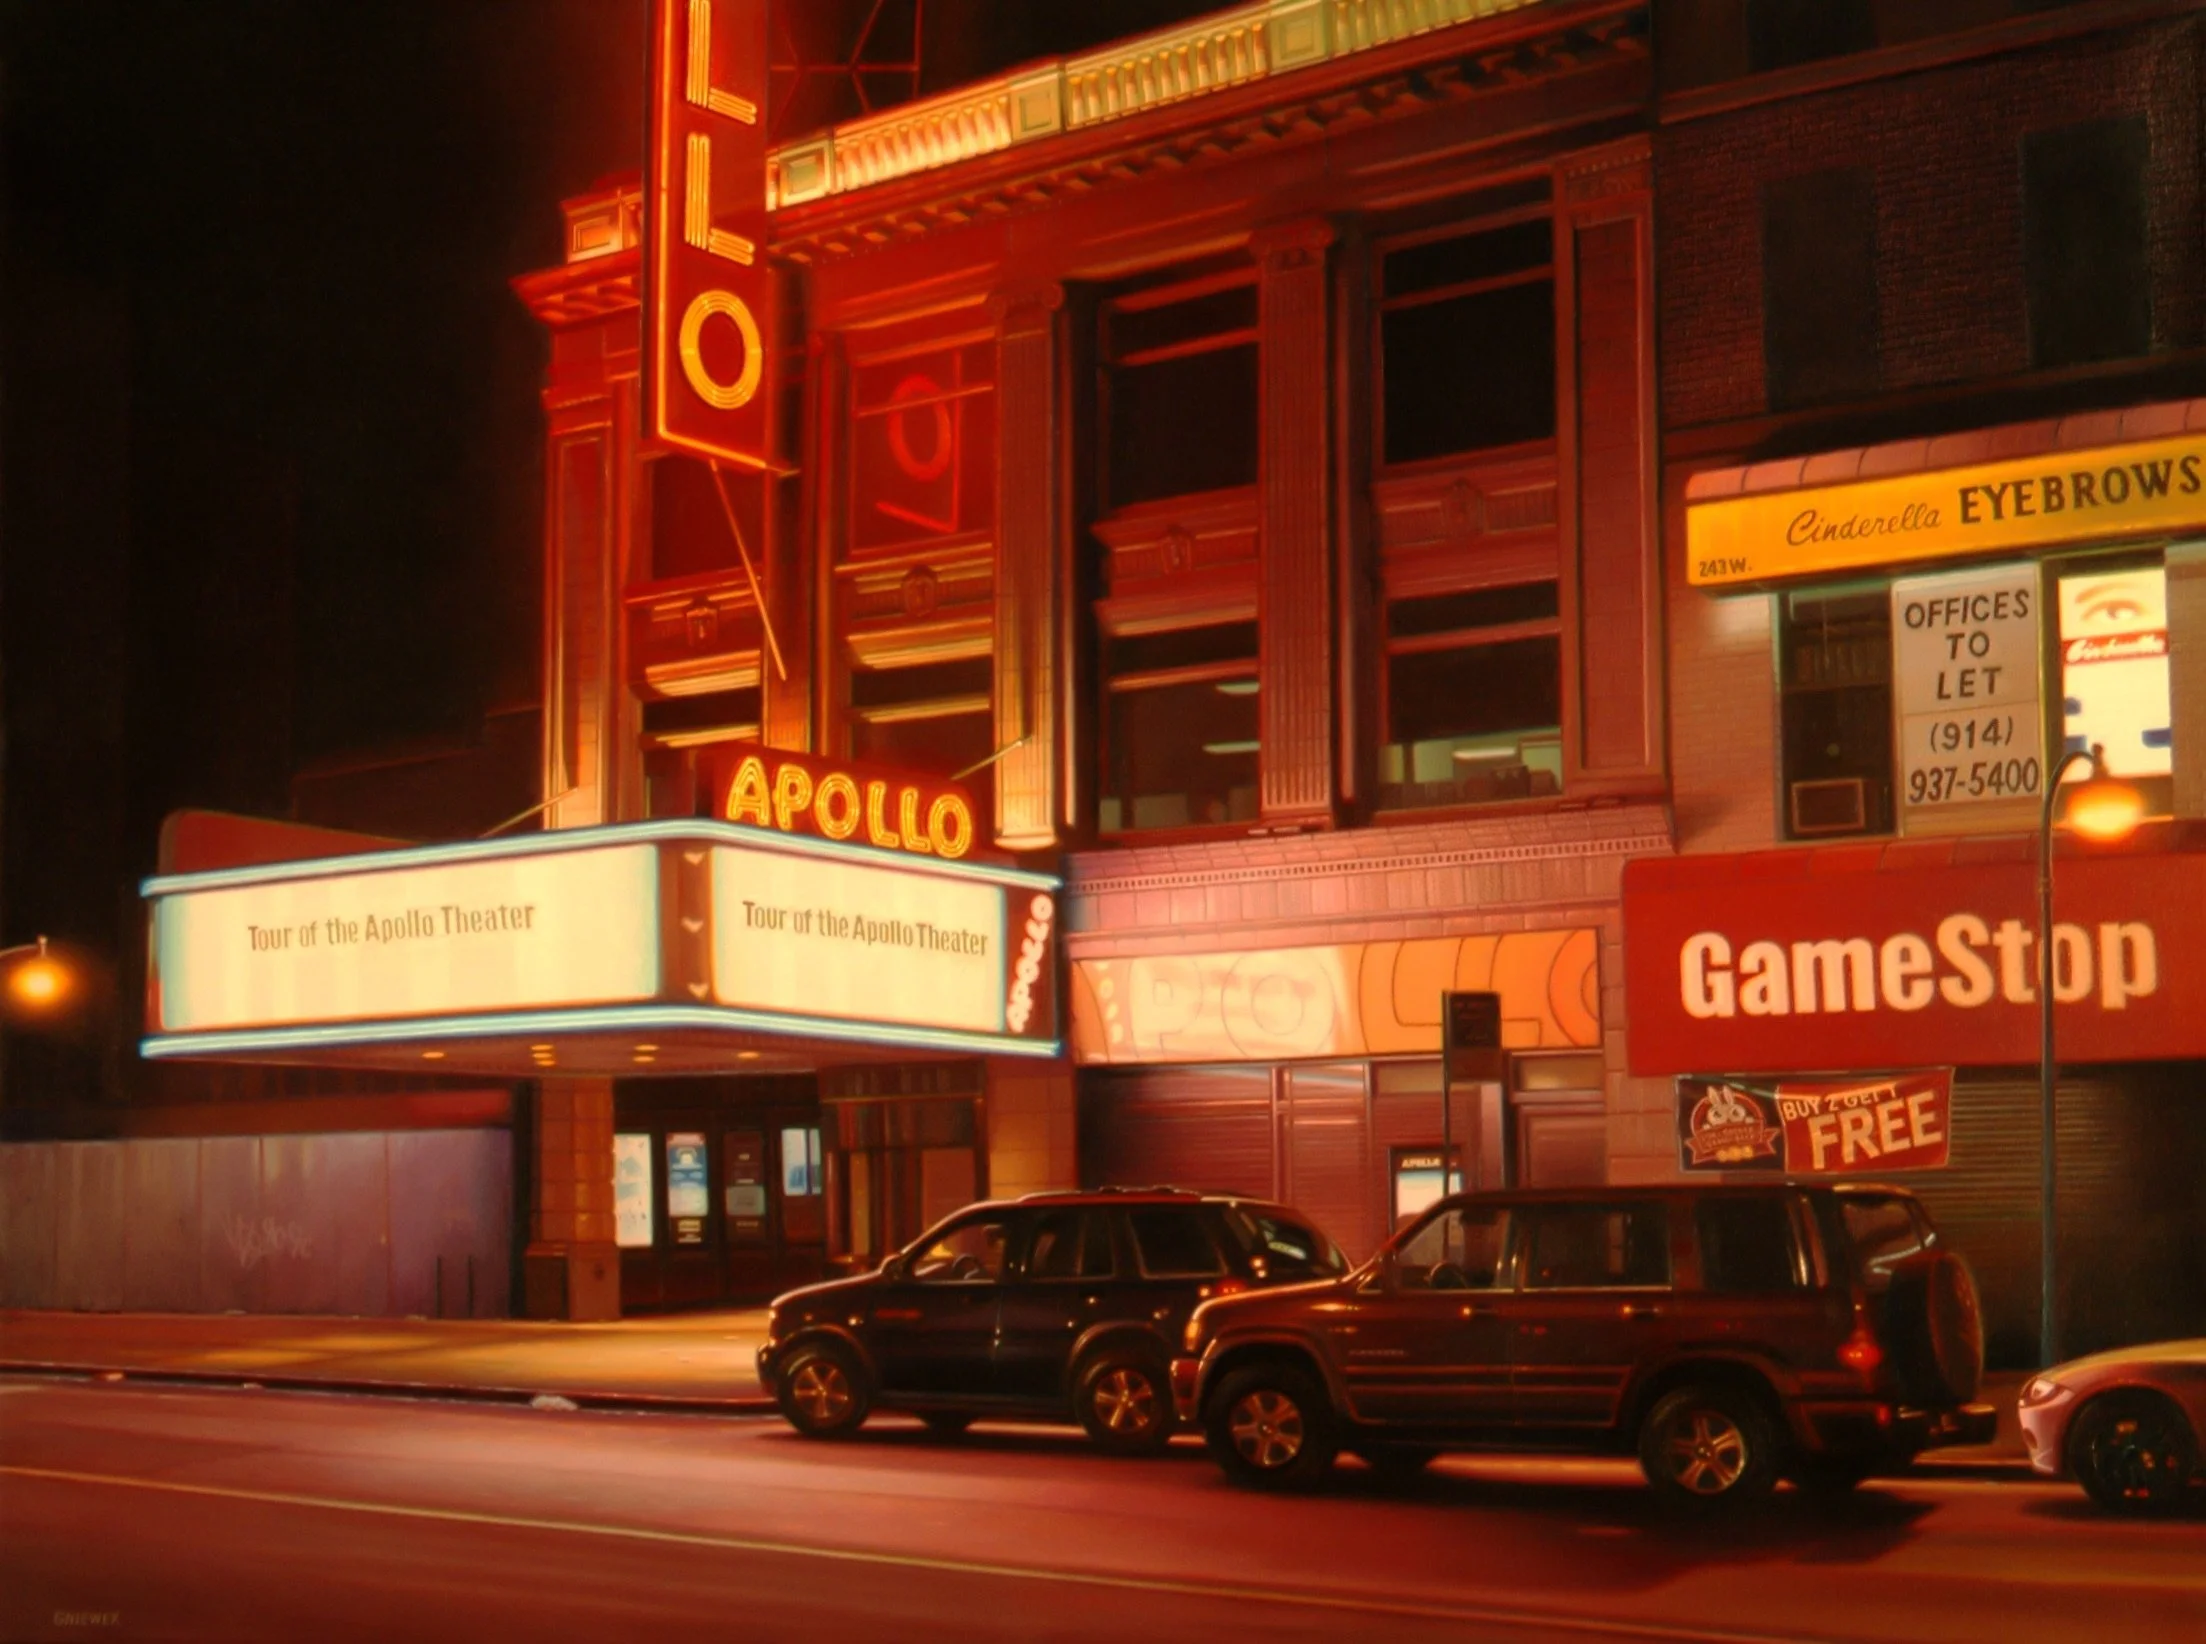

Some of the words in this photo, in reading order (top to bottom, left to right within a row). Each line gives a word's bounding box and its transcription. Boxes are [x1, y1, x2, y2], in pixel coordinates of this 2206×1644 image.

[1786, 502, 1942, 546] Cinderella
[1959, 455, 2202, 525] EYEBROWS
[1904, 589, 2030, 629] OFFICES
[1946, 630, 1990, 660] TO
[1937, 666, 2002, 700] LET
[1929, 715, 2014, 752] (914)
[1909, 756, 2039, 804] 937-5400
[726, 755, 973, 859] APOLLO
[248, 924, 293, 951] Tour
[300, 920, 318, 948] of
[326, 917, 359, 946] the
[365, 909, 435, 944] Apollo
[441, 904, 536, 936] Theater
[742, 900, 788, 930] Tour
[793, 908, 813, 934] of
[817, 909, 849, 938] the
[852, 914, 914, 947] Apollo
[915, 922, 989, 957] Theater
[1006, 894, 1054, 1033] APOLLO
[1680, 912, 2159, 1019] GameStop
[1782, 1097, 1821, 1121] BUY
[1807, 1089, 1943, 1170] FREE
